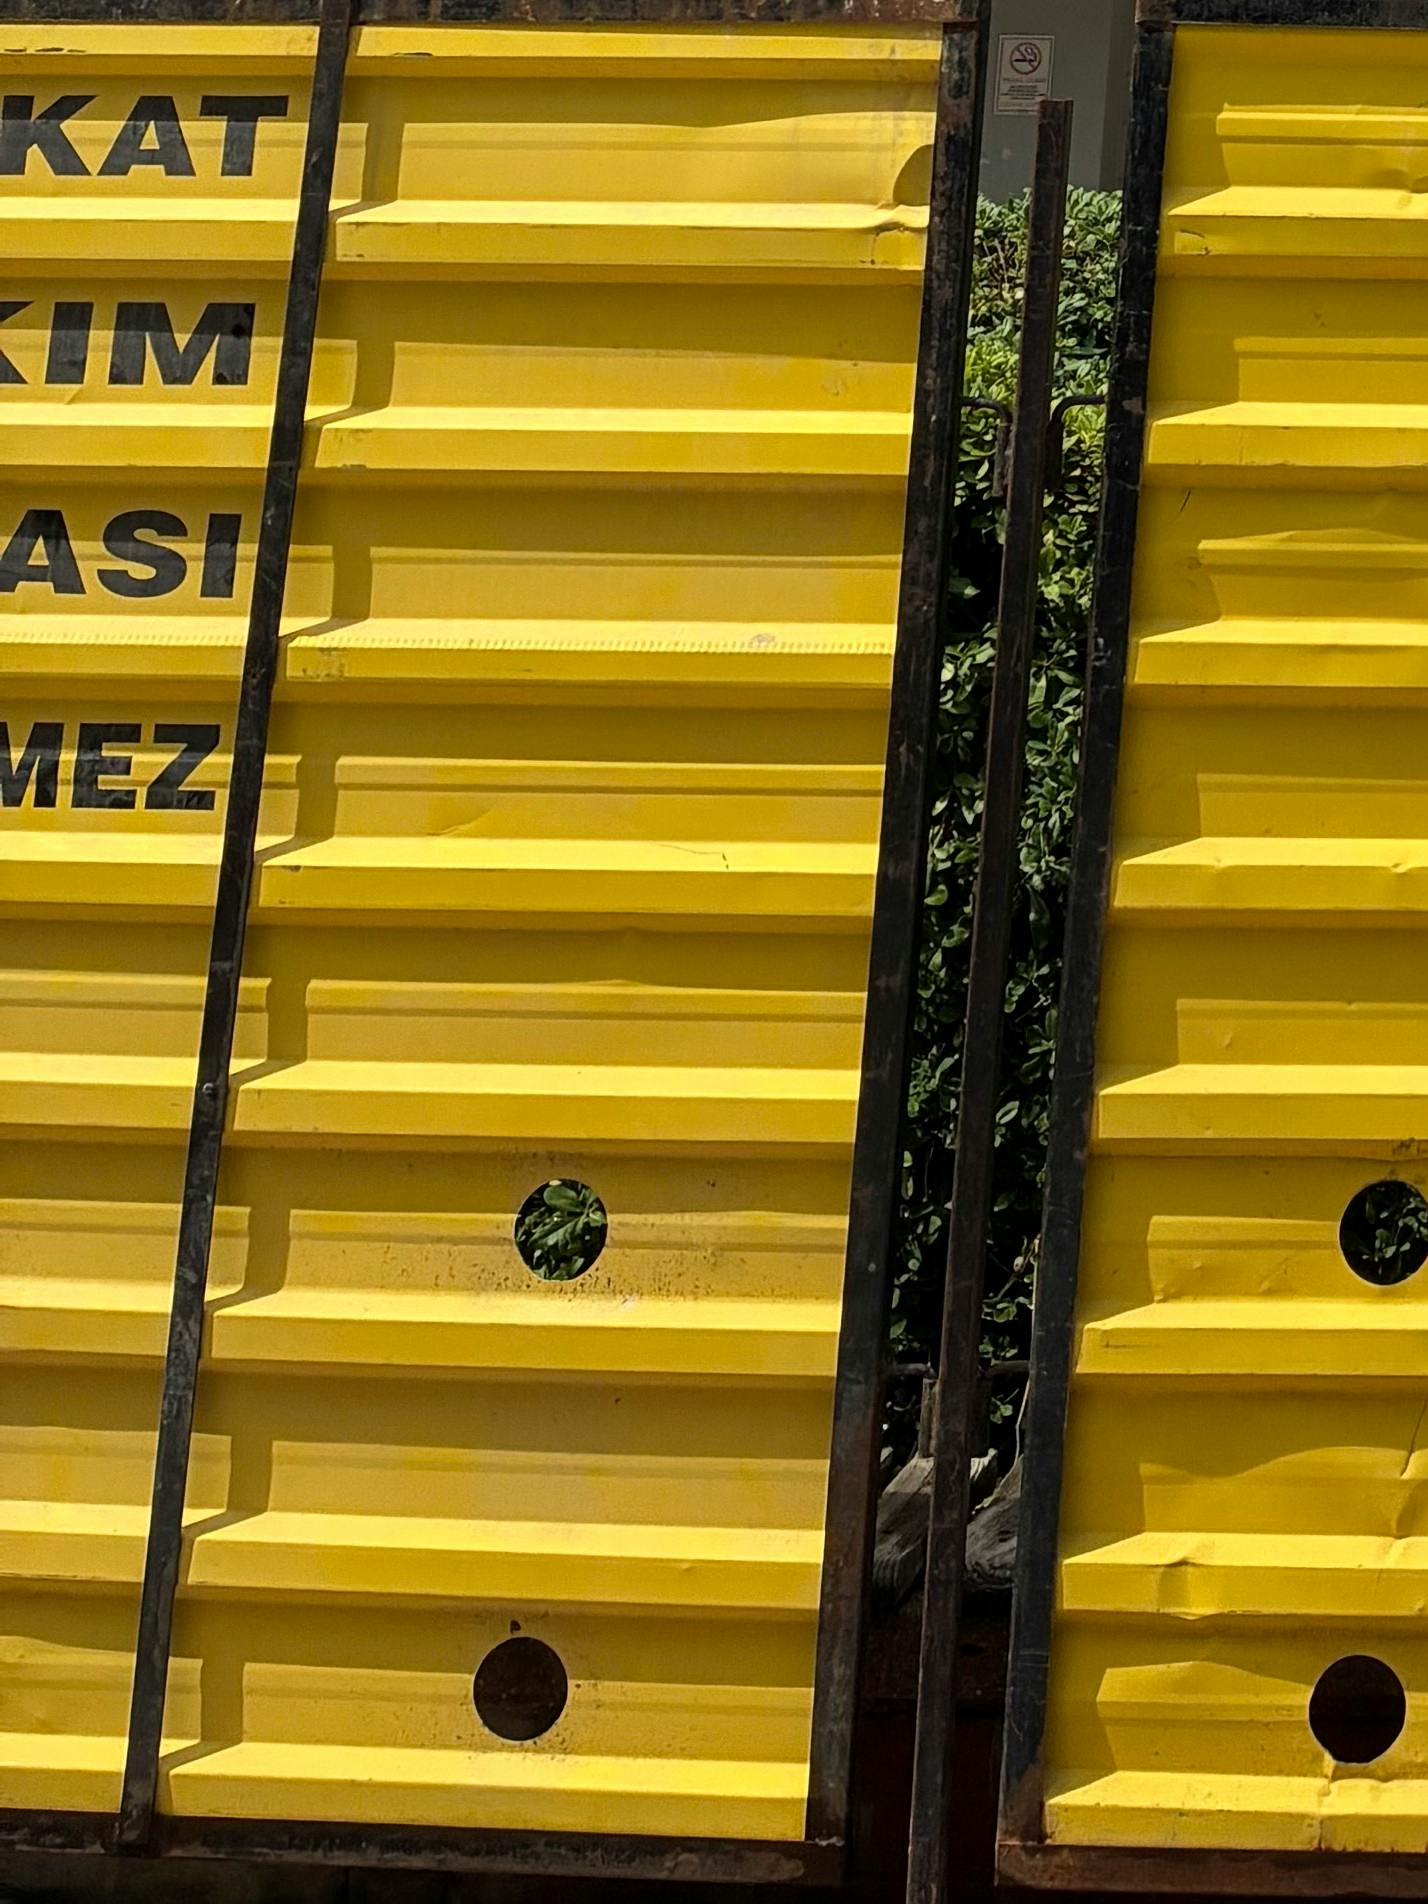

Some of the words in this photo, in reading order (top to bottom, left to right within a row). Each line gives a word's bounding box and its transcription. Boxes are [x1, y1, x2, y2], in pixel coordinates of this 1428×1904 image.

[0, 95, 289, 176] KAT
[0, 301, 256, 385] IM
[0, 509, 242, 598] ASI
